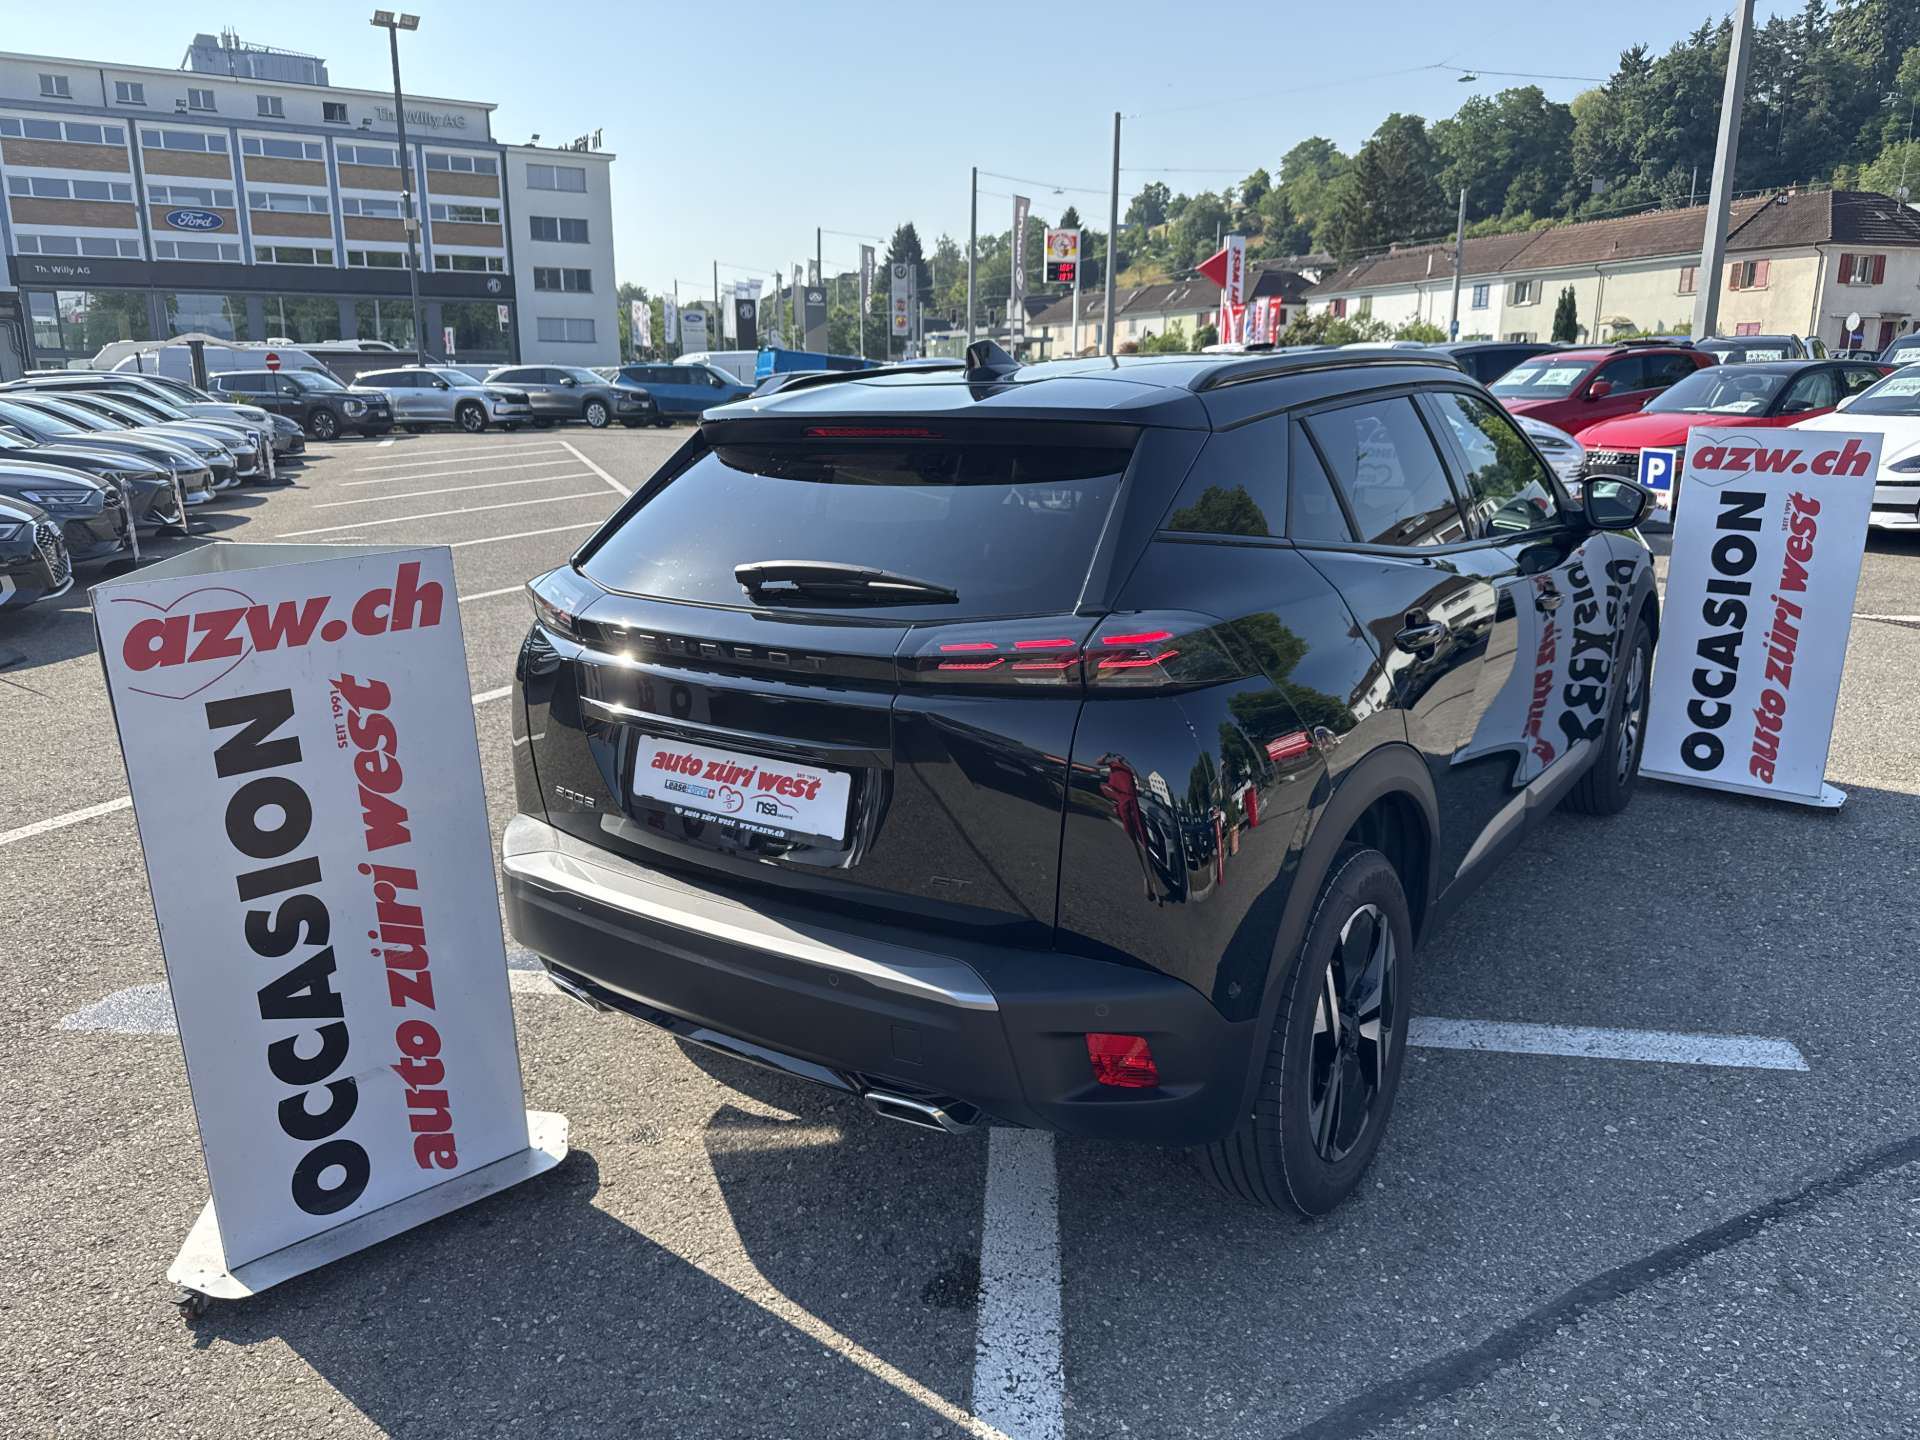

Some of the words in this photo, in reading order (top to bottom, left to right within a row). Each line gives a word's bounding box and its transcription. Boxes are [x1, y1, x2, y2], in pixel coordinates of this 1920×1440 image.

[403, 109, 440, 128] Willy
[441, 113, 466, 128] AG
[176, 211, 213, 228] Ford
[34, 264, 50, 273] Th.
[51, 264, 75, 276] Willy
[77, 265, 91, 275] AG
[1646, 457, 1666, 485] P
[1692, 439, 1872, 477] azw.ch
[1781, 516, 1790, 532] SEIT
[1783, 499, 1792, 515] 1991
[1780, 491, 1822, 593] west
[123, 562, 443, 672] azw.ch
[1680, 490, 1767, 772] OCCASION
[611, 629, 828, 671] PEUGEOT
[1763, 593, 1803, 690] züri
[329, 690, 344, 719] 1991
[334, 723, 348, 749] SEIT
[1750, 688, 1787, 785] auto
[328, 673, 413, 853] west
[651, 751, 703, 777] auto
[702, 760, 758, 788] züri
[757, 771, 822, 801] west
[555, 784, 596, 809] 2008
[756, 800, 778, 817] nsa
[683, 809, 700, 819] auto
[700, 812, 718, 823] züri
[718, 816, 736, 828] west
[739, 821, 786, 839] www.azw.ch
[205, 688, 371, 1216] OCCASION
[358, 862, 437, 1012] züri
[389, 1019, 459, 1171] auto
